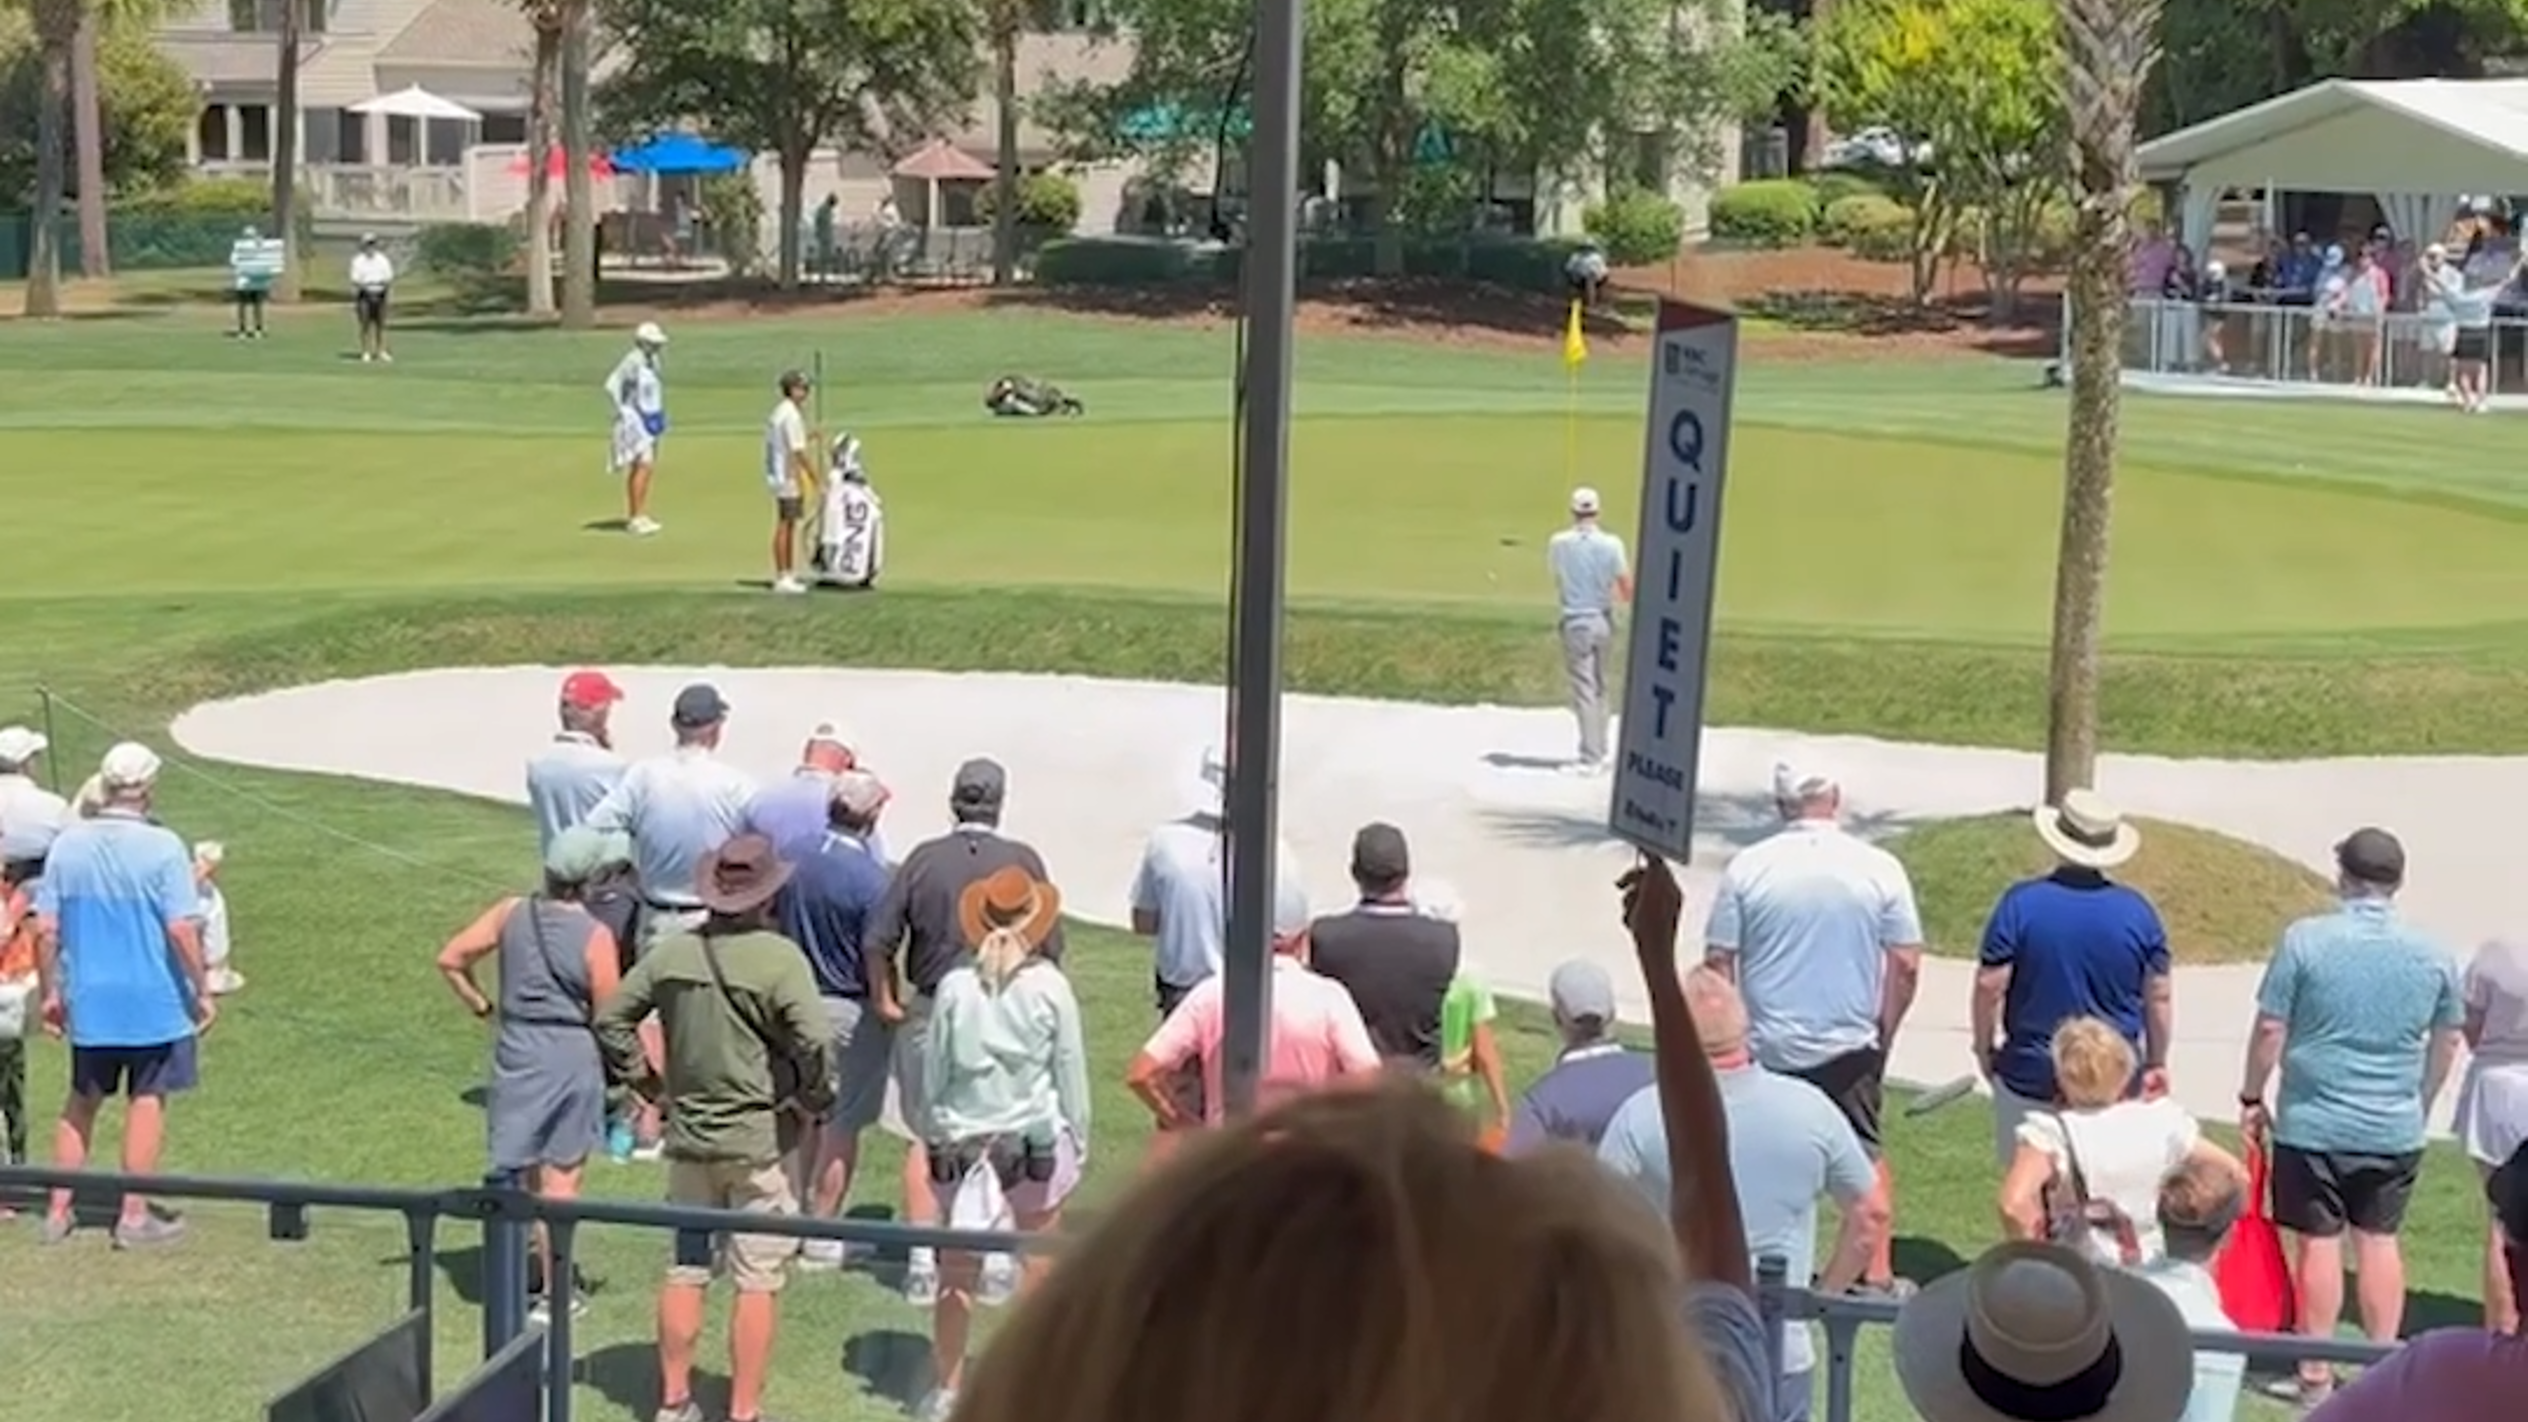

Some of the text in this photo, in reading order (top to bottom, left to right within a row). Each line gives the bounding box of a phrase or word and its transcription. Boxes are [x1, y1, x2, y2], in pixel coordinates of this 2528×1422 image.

[840, 501, 869, 575] PING
[1652, 409, 1704, 739] QUIET
[1626, 751, 1684, 792] PLEASE
